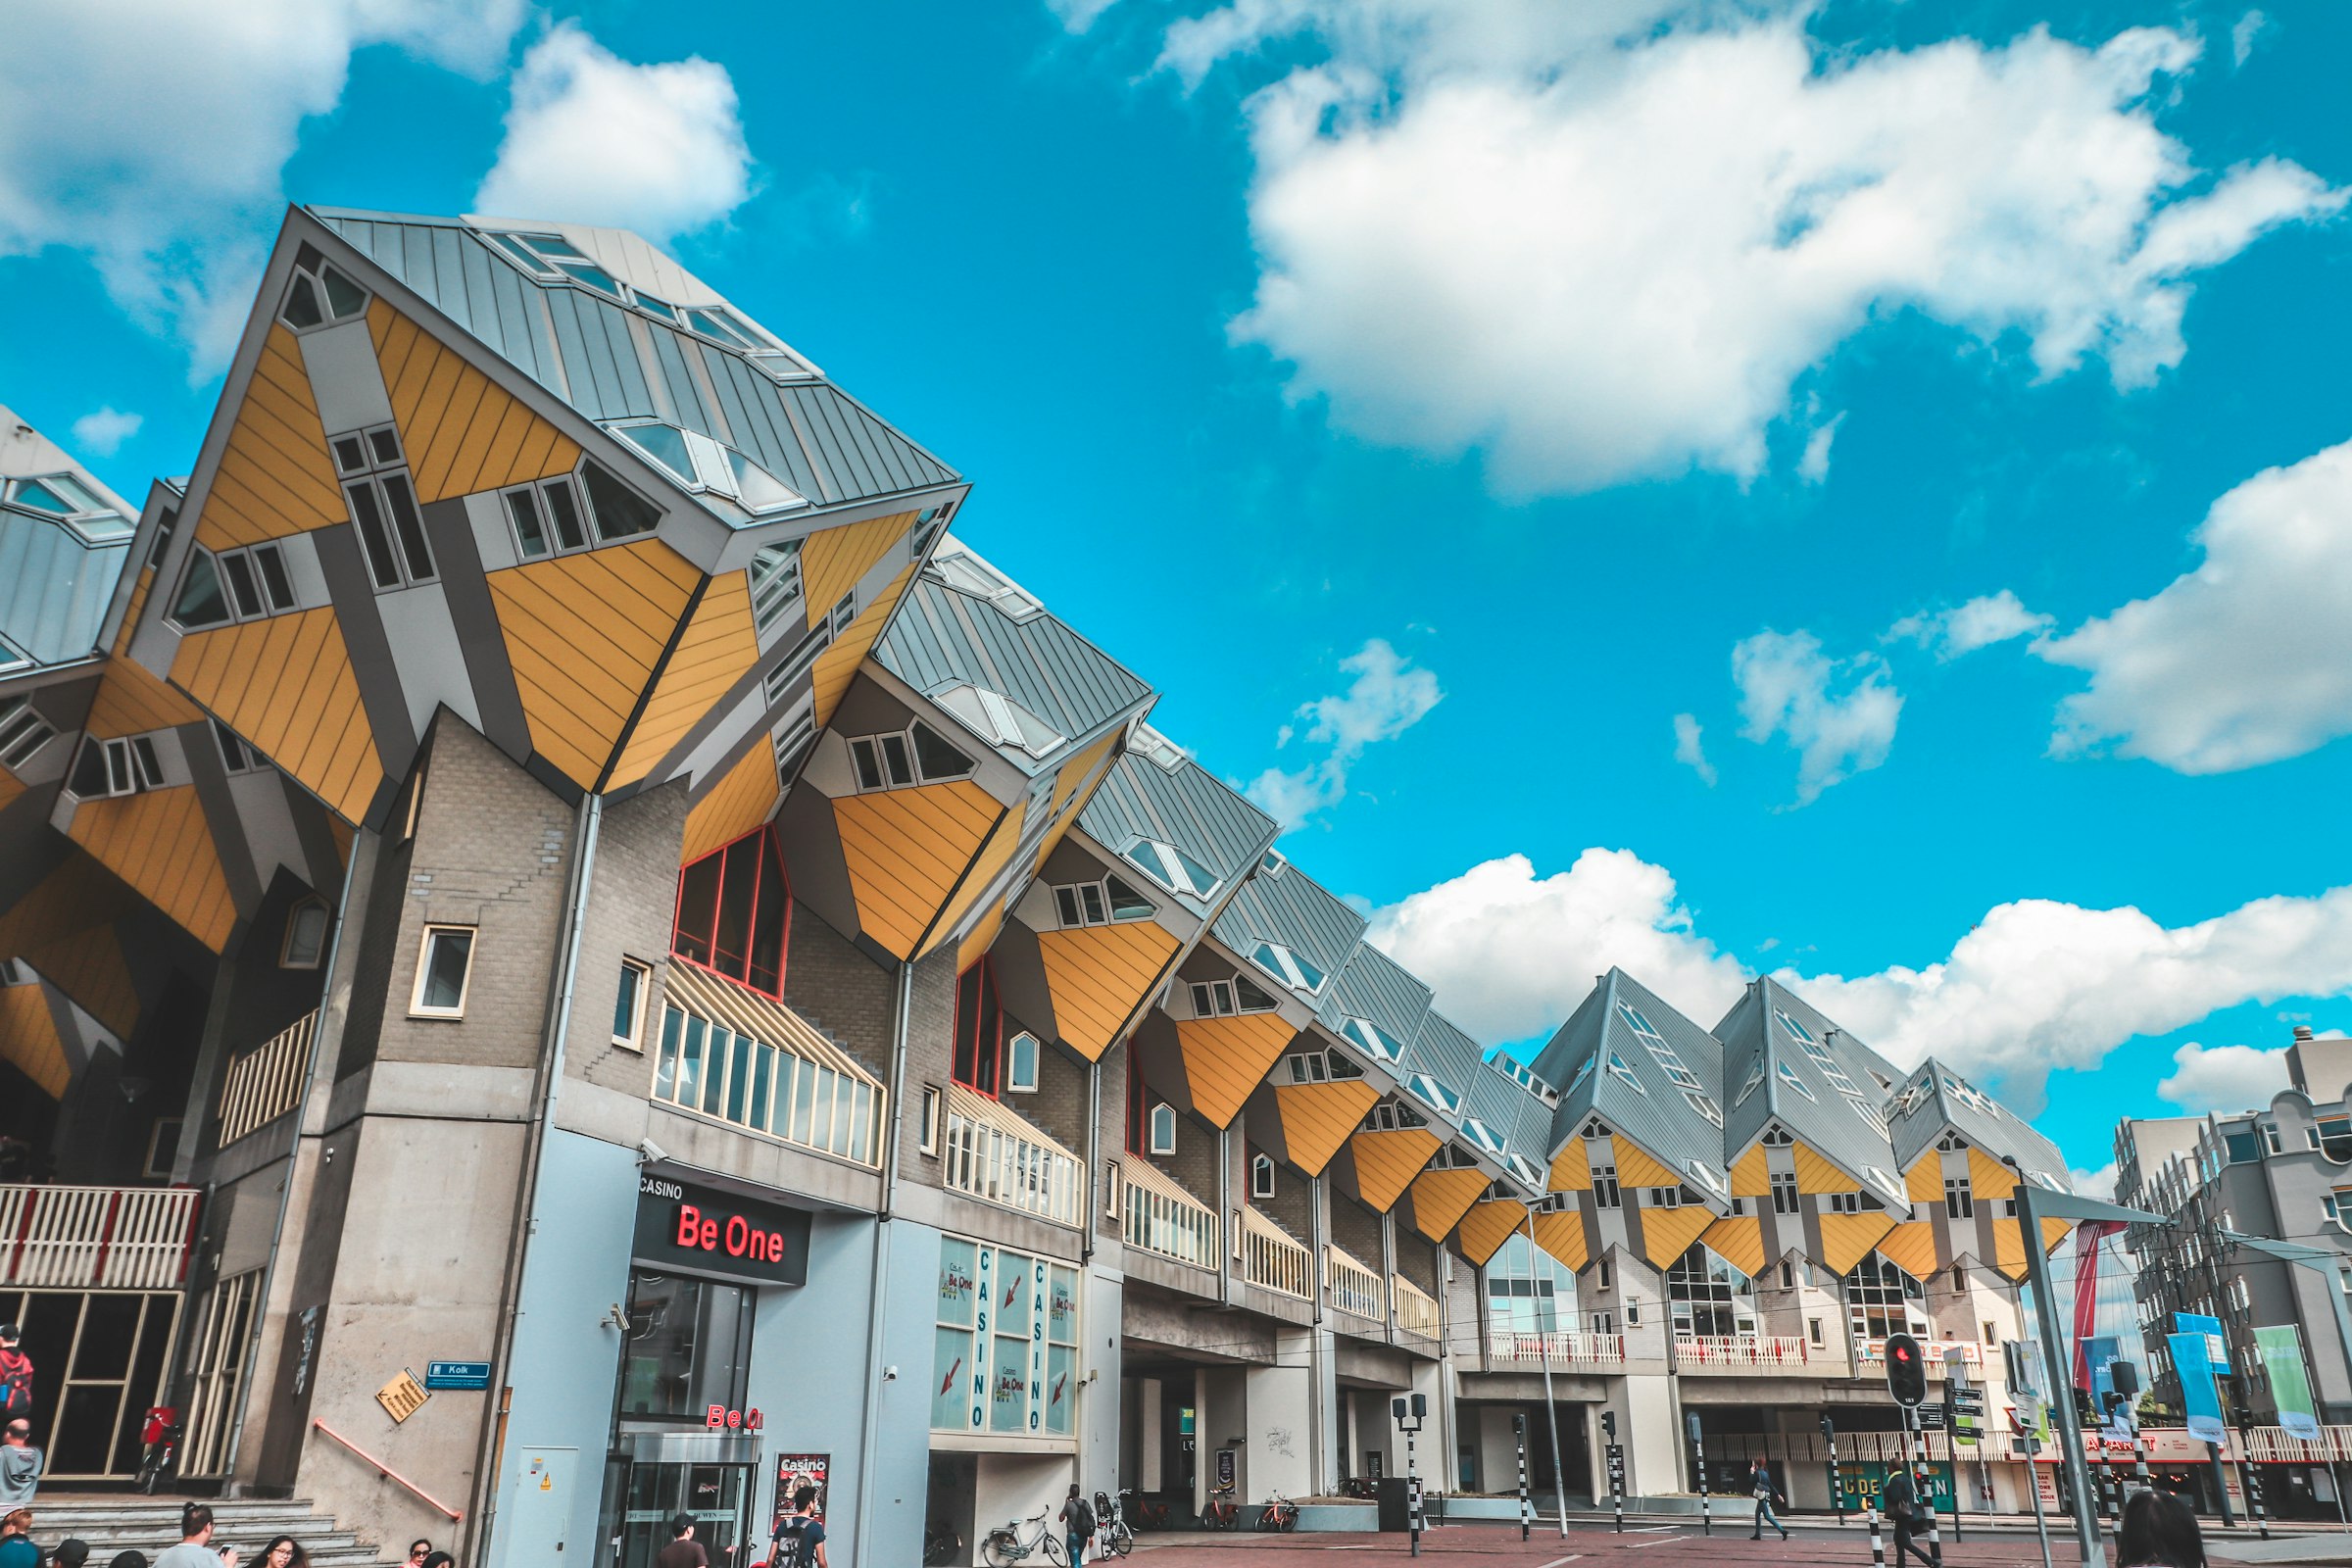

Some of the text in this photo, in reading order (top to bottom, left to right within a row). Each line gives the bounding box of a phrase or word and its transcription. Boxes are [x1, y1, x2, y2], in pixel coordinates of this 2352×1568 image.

[640, 1177, 682, 1200] CASINO
[677, 1204, 784, 1263] Be One
[972, 1250, 990, 1427] CASINO
[1030, 1265, 1044, 1430] CASINO
[448, 1365, 468, 1374] Kolk
[707, 1404, 741, 1428] Be
[2085, 1437, 2156, 1450] AANT
[781, 1457, 826, 1472] Casino
